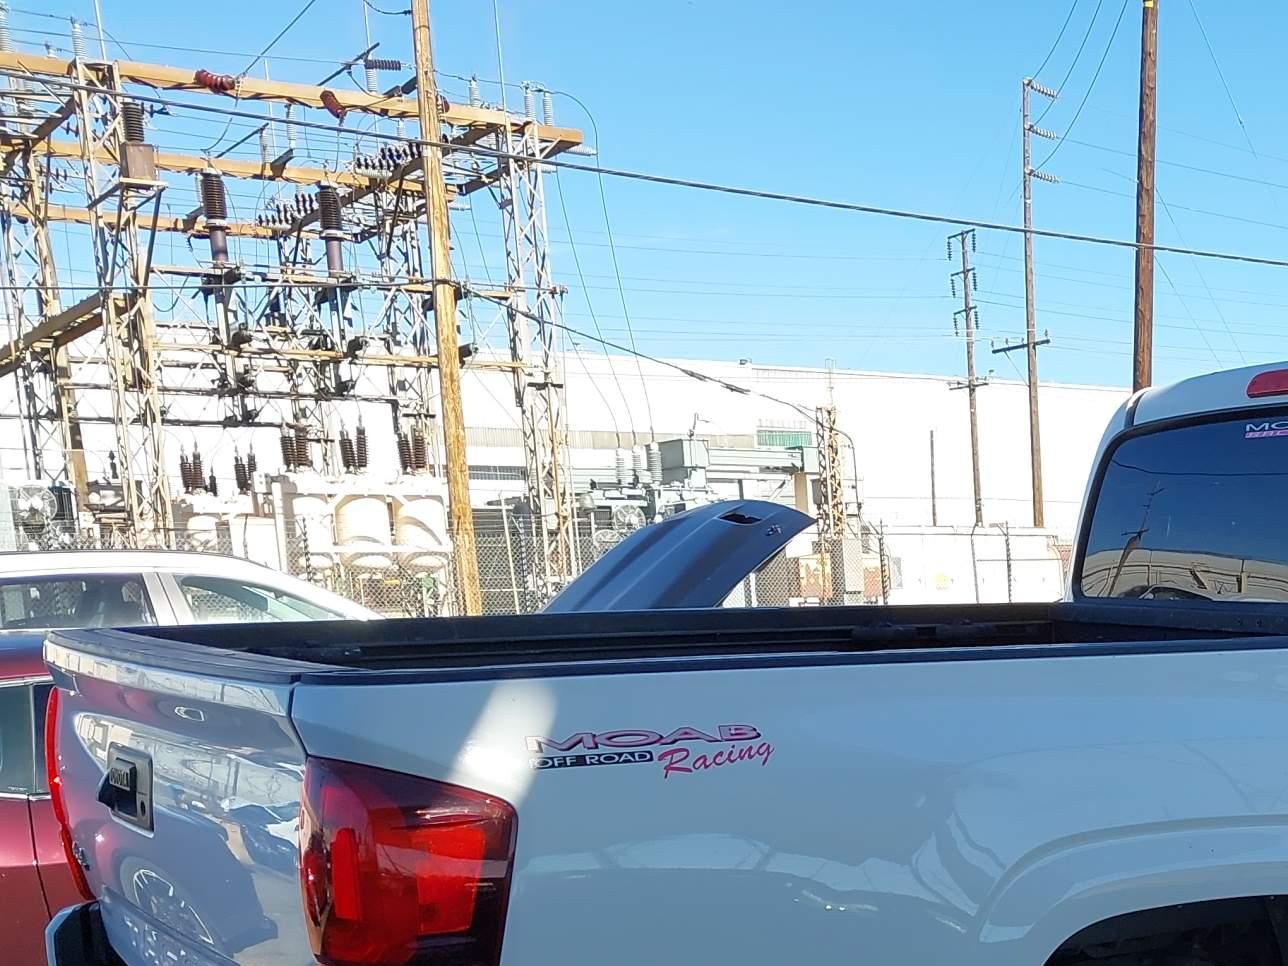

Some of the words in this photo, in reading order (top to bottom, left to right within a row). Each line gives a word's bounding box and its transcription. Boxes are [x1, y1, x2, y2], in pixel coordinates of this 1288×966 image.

[524, 724, 762, 753] MOAB
[532, 755, 577, 769] OFF
[584, 750, 652, 765] ROAD
[657, 742, 775, 779] Racing
